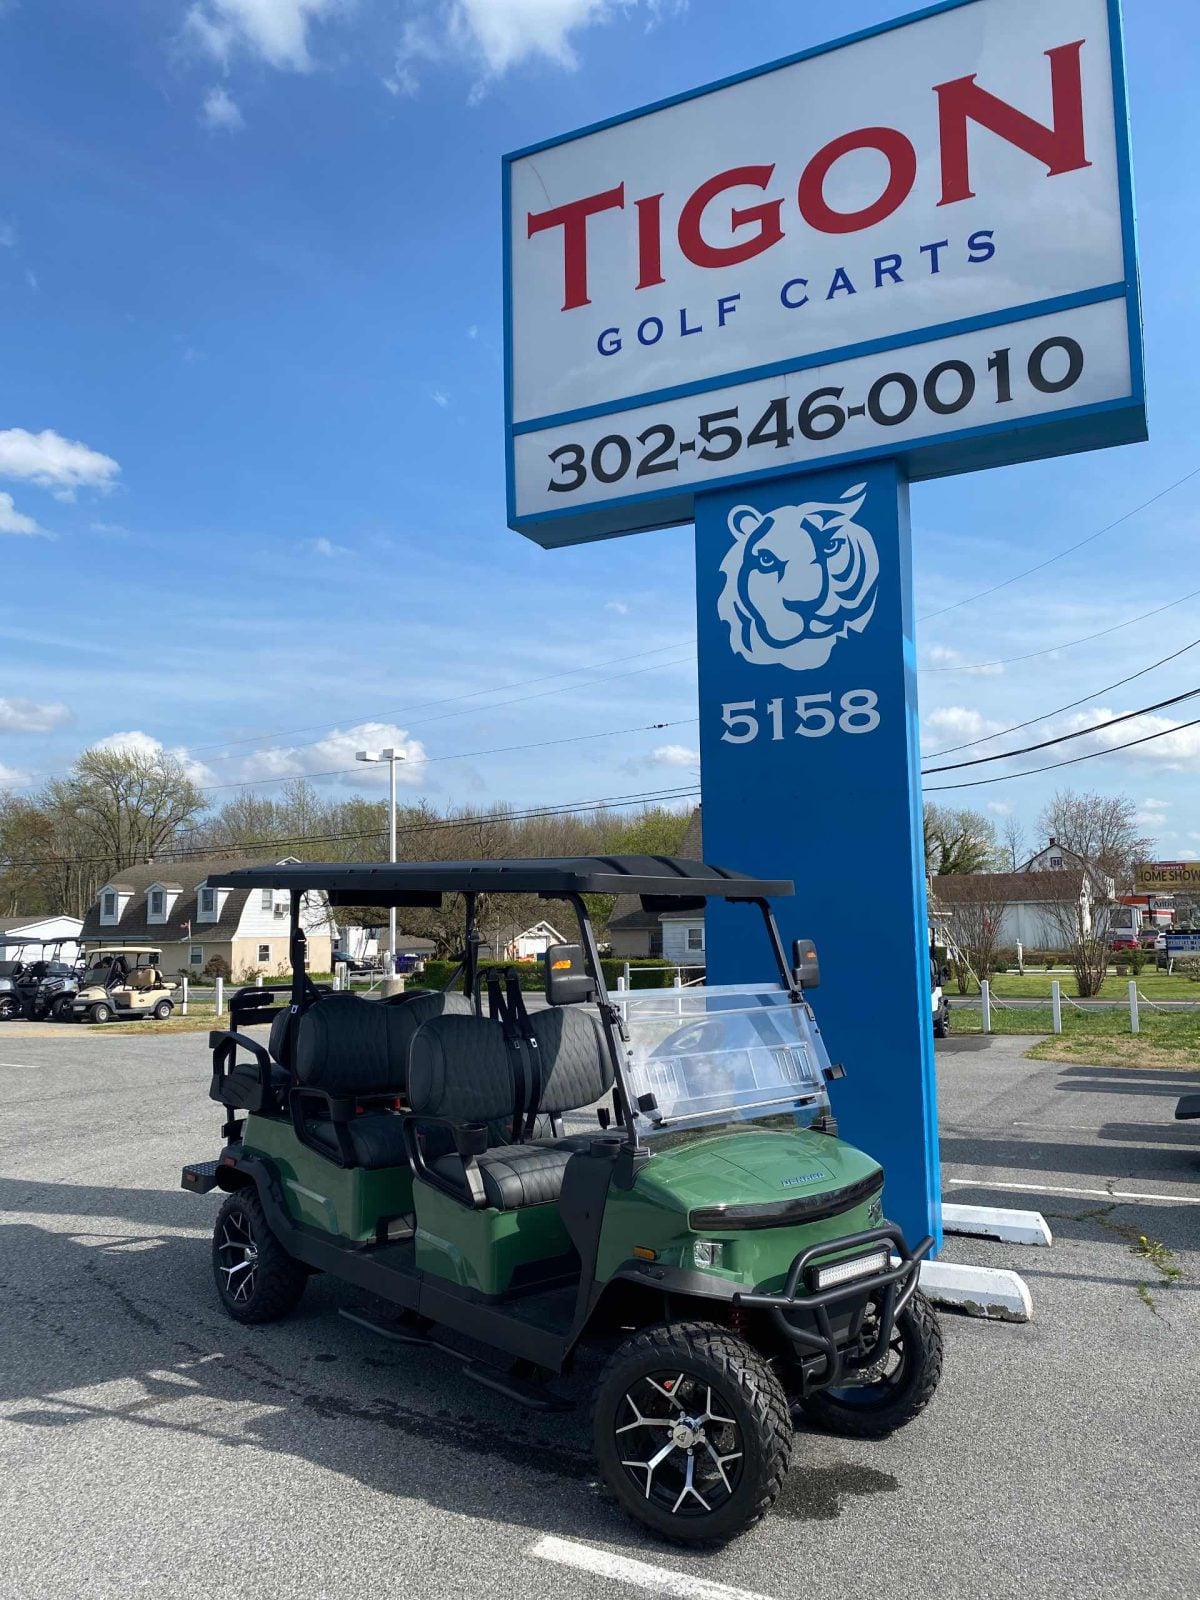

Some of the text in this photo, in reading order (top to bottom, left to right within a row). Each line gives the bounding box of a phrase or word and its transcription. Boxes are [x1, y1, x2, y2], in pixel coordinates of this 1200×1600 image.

[527, 39, 1092, 312] TIGON
[596, 230, 996, 357] GOLF CARTS
[547, 336, 1084, 492] 302-546-0010
[720, 688, 881, 744] 5158
